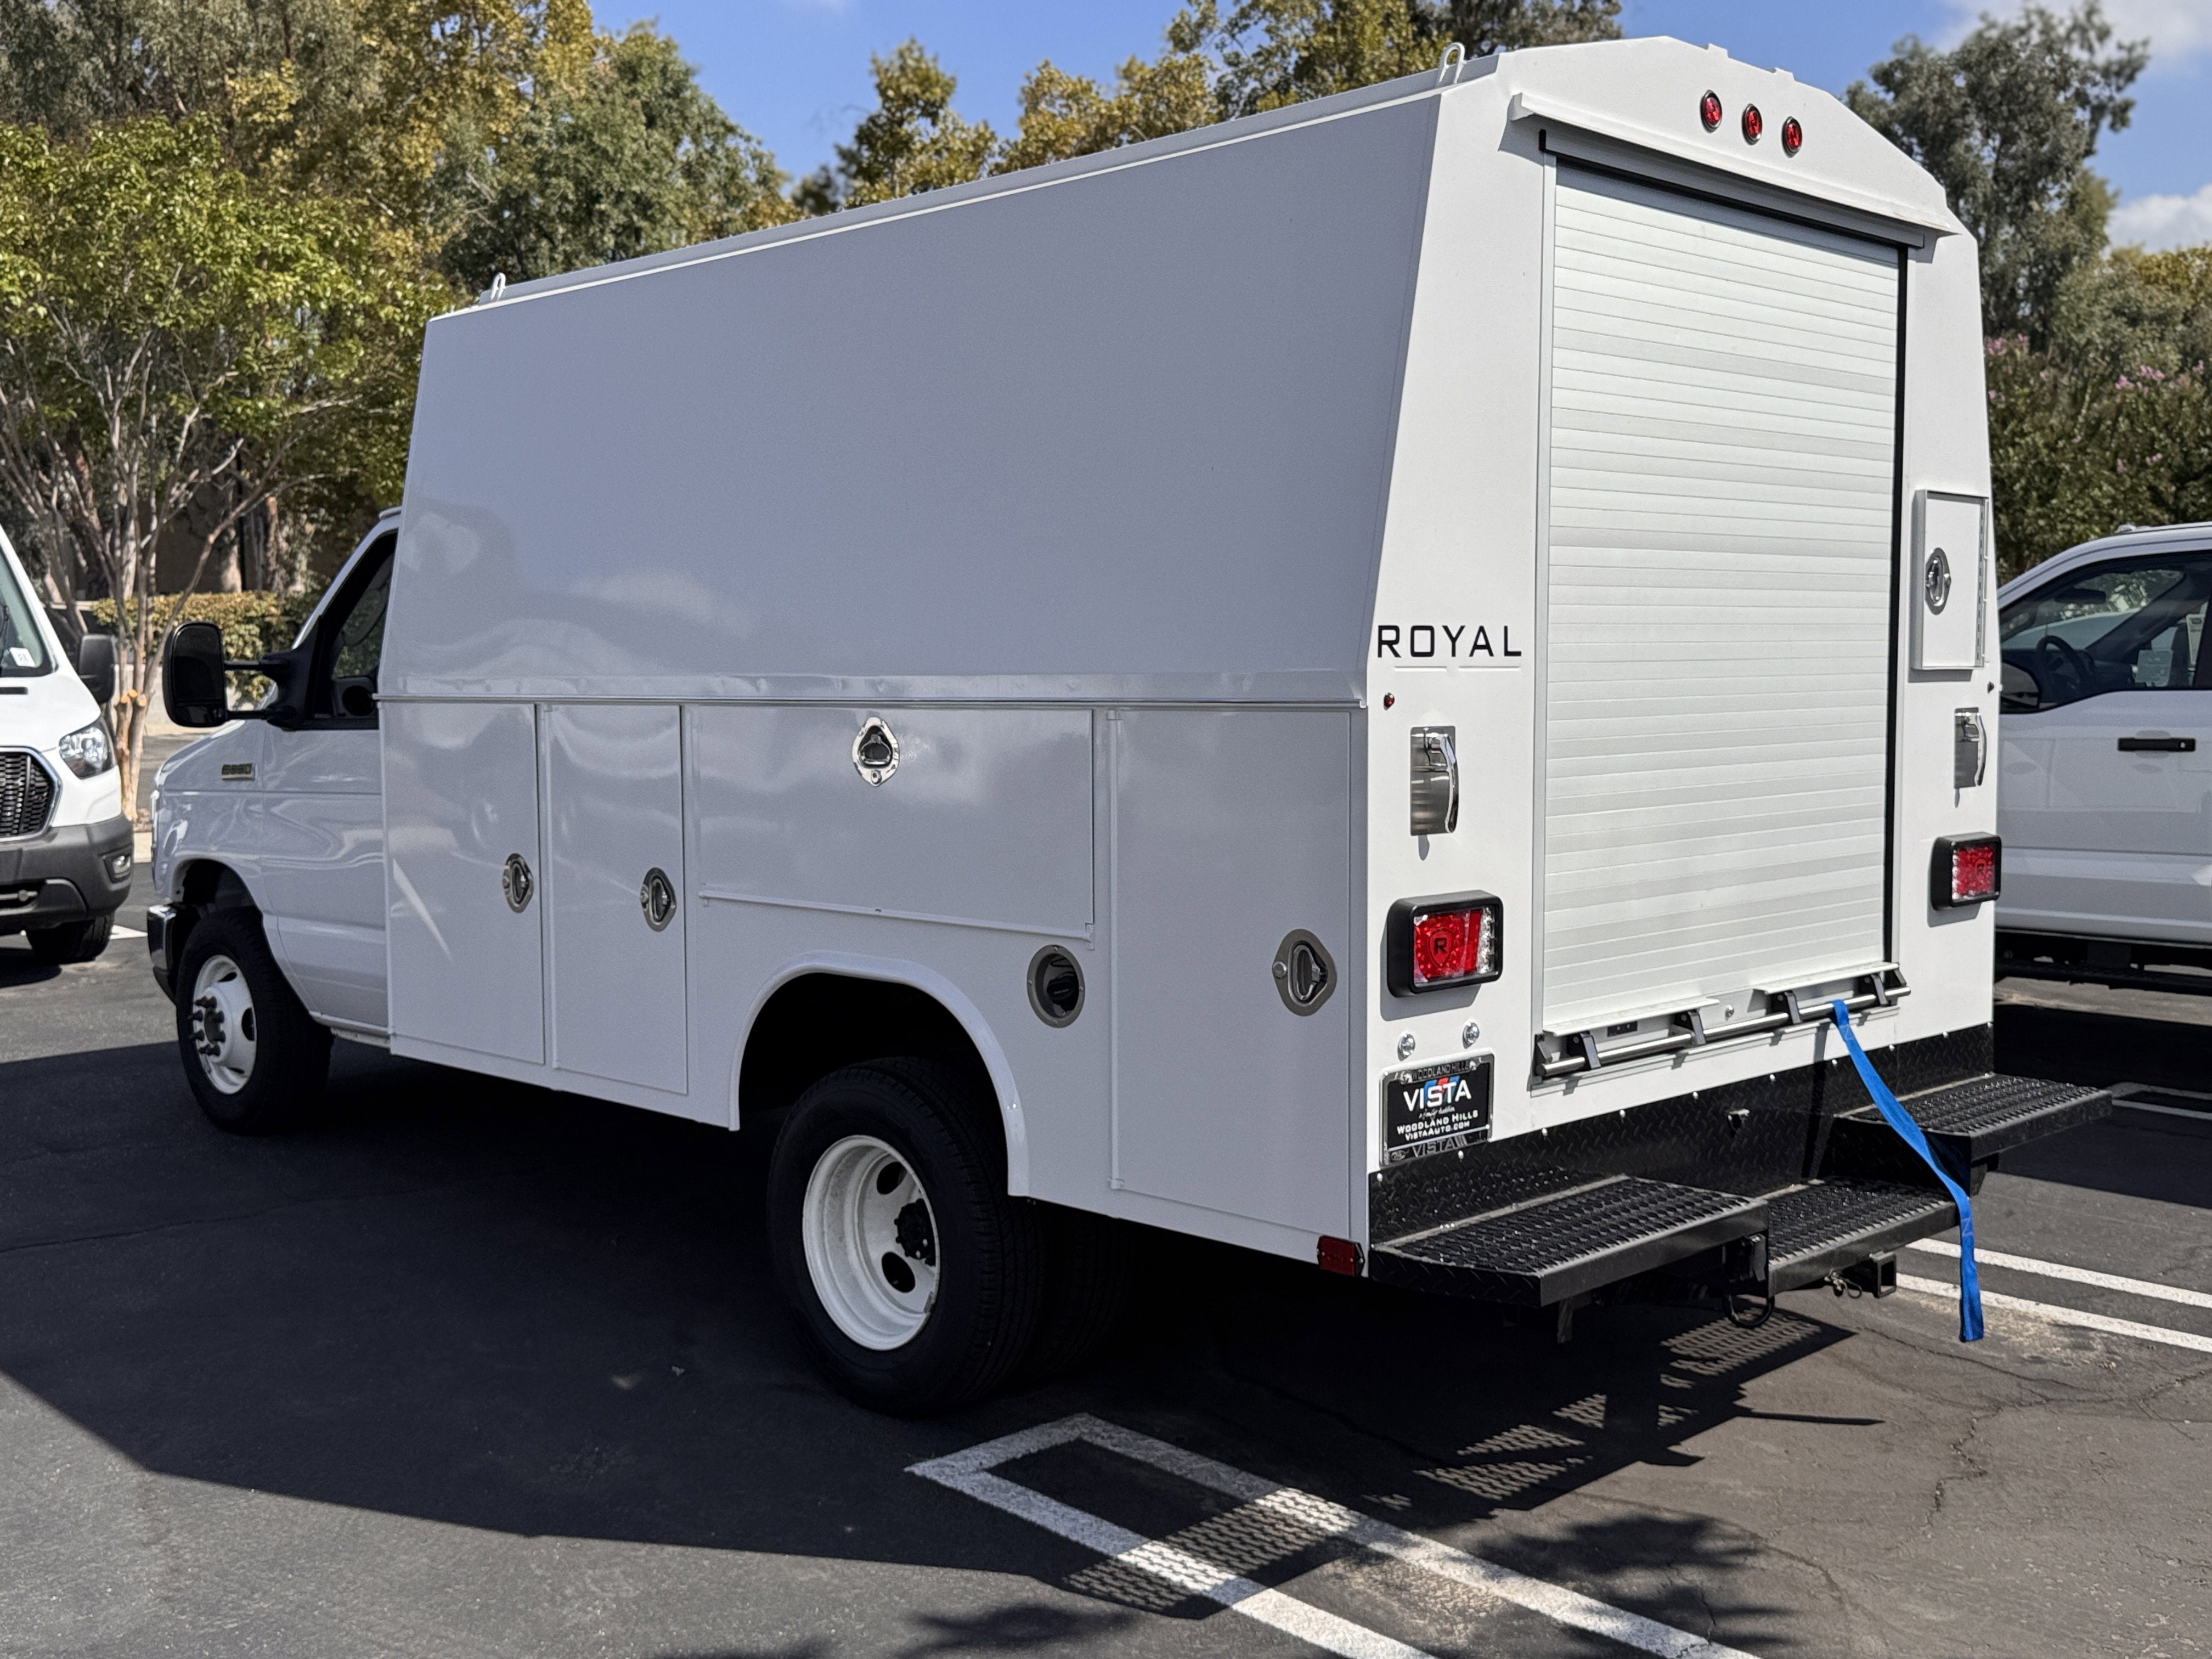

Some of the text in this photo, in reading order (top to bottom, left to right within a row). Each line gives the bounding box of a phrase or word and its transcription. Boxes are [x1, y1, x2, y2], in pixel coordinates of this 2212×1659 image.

[1377, 625, 1522, 658] ROYAL
[1434, 937, 1447, 955] R
[1412, 1064, 1451, 1080] WOODLAND
[1403, 1079, 1471, 1111] VISTA
[1397, 1117, 1449, 1135] WOODLAND
[1452, 1110, 1479, 1122] HILLS
[1405, 1121, 1470, 1141] VISTAAUTO.COM
[1412, 1137, 1456, 1158] VISTA
